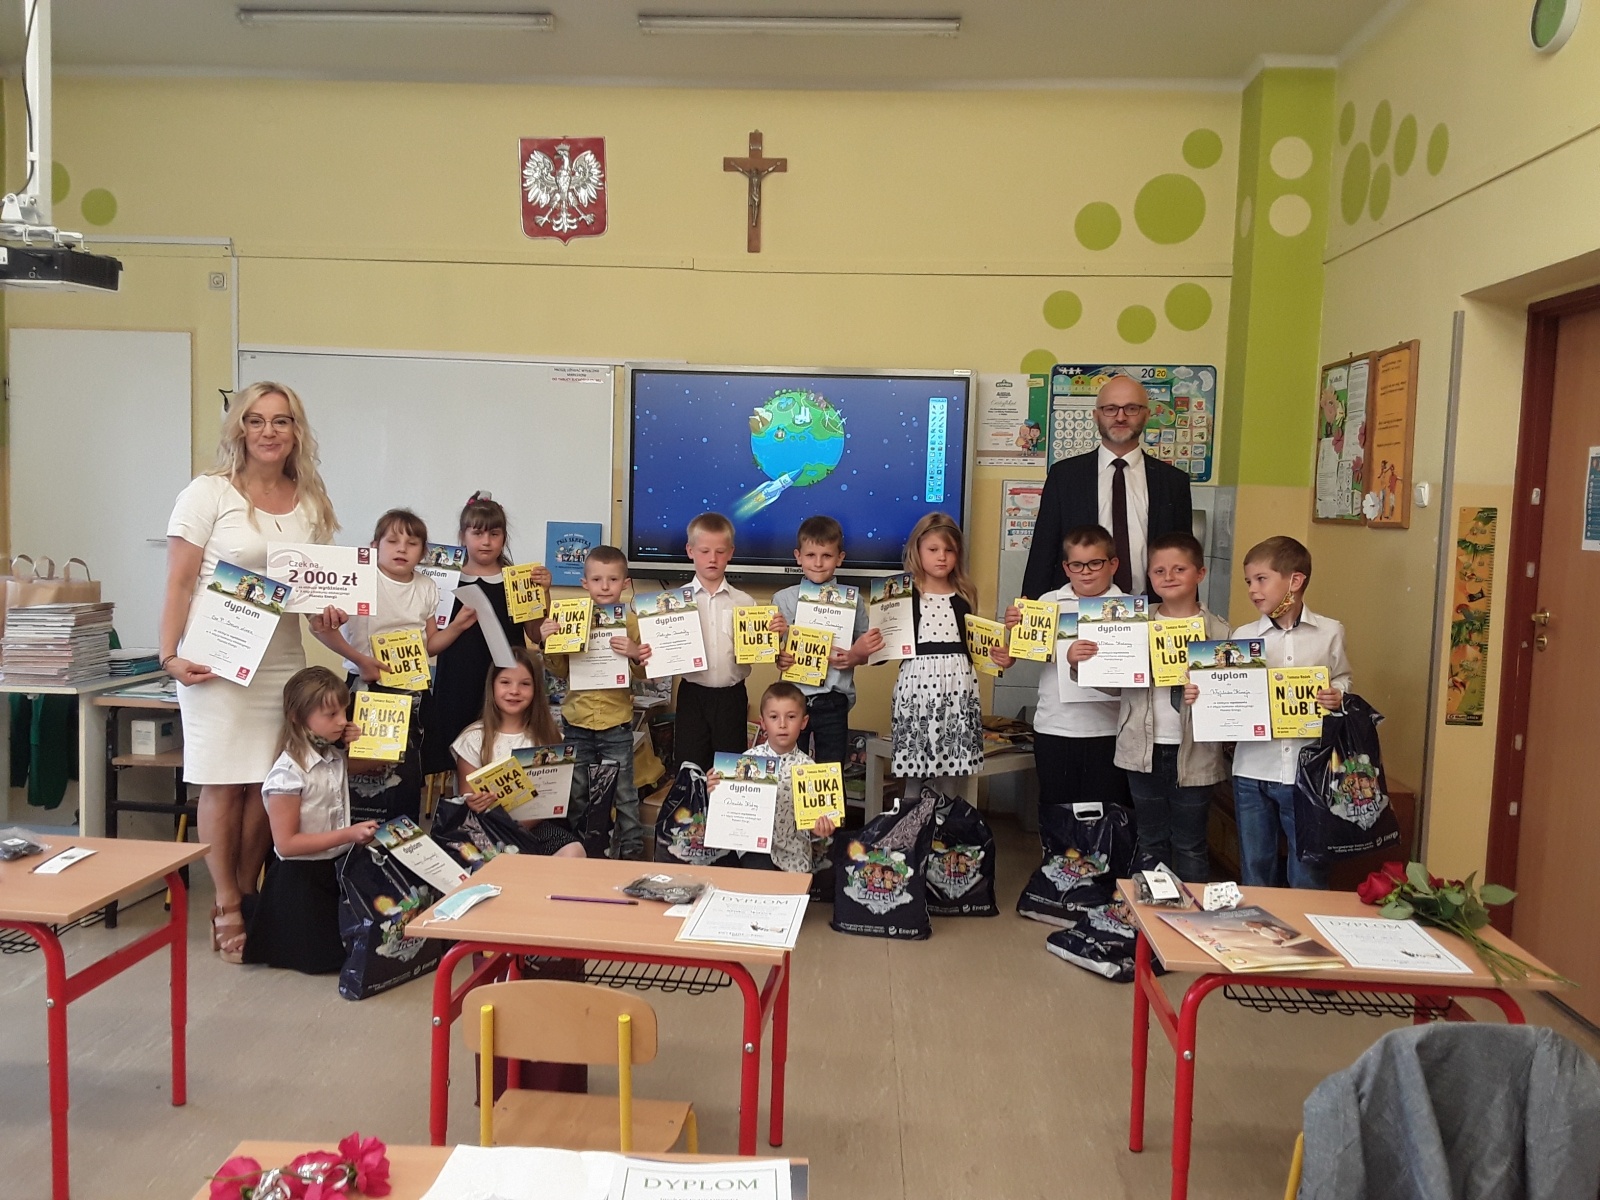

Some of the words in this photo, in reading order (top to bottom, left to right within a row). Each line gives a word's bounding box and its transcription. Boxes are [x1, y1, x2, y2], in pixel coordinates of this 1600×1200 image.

[1141, 368, 1155, 379] 20
[288, 560, 308, 568] Czek
[309, 561, 319, 569] na
[288, 569, 299, 583] 2
[304, 570, 338, 585] 000
[342, 572, 358, 586] zł
[421, 568, 448, 578] dyplom
[224, 599, 261, 619] dyplom
[813, 605, 842, 616] dyplom
[880, 601, 900, 612] dyplom
[655, 615, 685, 626] dyplom
[1097, 624, 1132, 633] dyplom
[589, 631, 613, 640] yplom
[970, 643, 989, 657] LUB
[1161, 650, 1187, 665] LUB
[1210, 671, 1248, 681] dyplom
[526, 768, 558, 777] dyplom
[729, 783, 761, 793] dyplom
[402, 840, 423, 854] dyplom
[722, 896, 789, 905] DYPLOM
[1328, 920, 1402, 930] DYPLOM
[898, 927, 919, 935] Energa
[643, 1177, 760, 1191] DYPLOM
